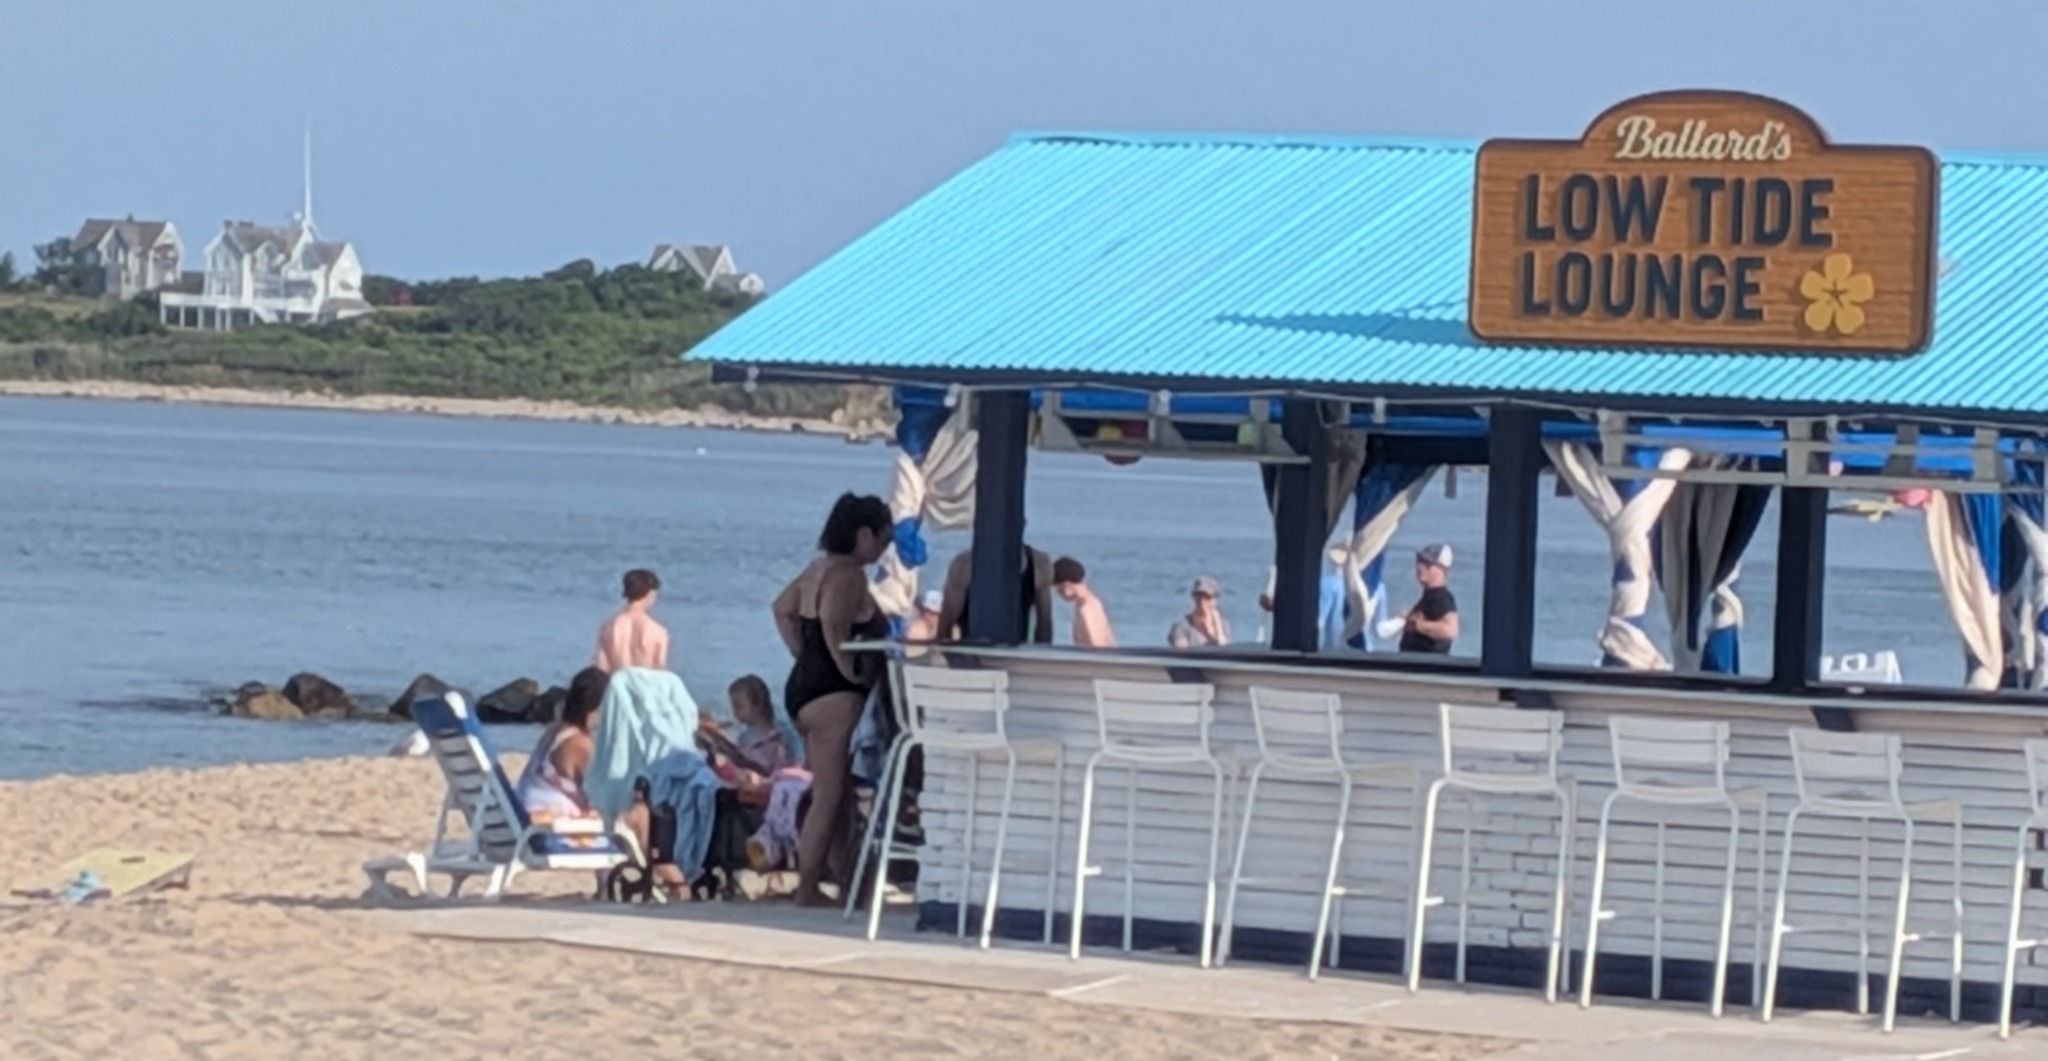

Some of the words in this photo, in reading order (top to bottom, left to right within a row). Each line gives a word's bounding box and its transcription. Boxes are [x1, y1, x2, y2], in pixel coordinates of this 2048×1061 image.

[1615, 115, 1792, 162] Ballard's
[1525, 173, 1668, 242] LOW
[1690, 177, 1834, 247] TIDE
[1521, 251, 1766, 321] LOUNGE
